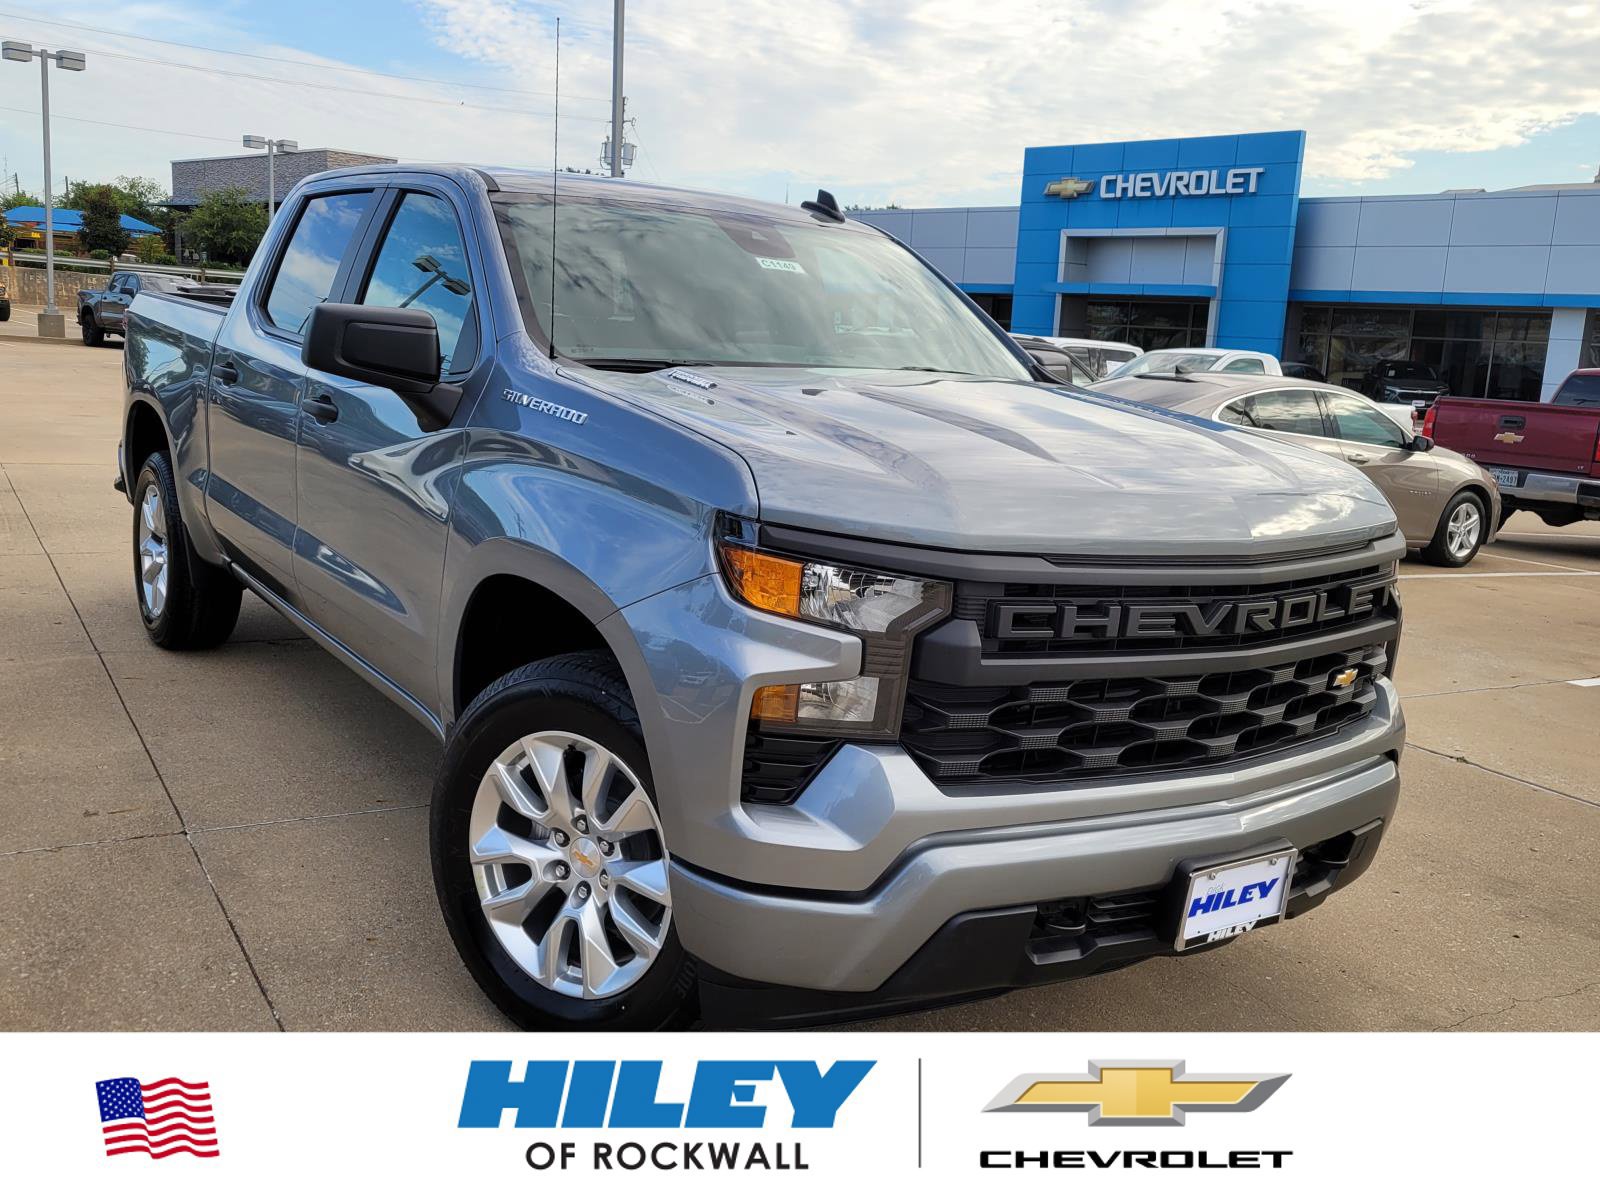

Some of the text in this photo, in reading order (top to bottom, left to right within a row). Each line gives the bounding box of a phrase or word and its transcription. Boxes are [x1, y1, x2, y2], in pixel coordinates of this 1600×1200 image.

[1100, 167, 1265, 199] CHEVROLET
[503, 389, 588, 425] SILVERADO
[996, 578, 1397, 638] CHEVROLET
[1187, 877, 1280, 918] HILEY
[1207, 920, 1257, 942] HILEY
